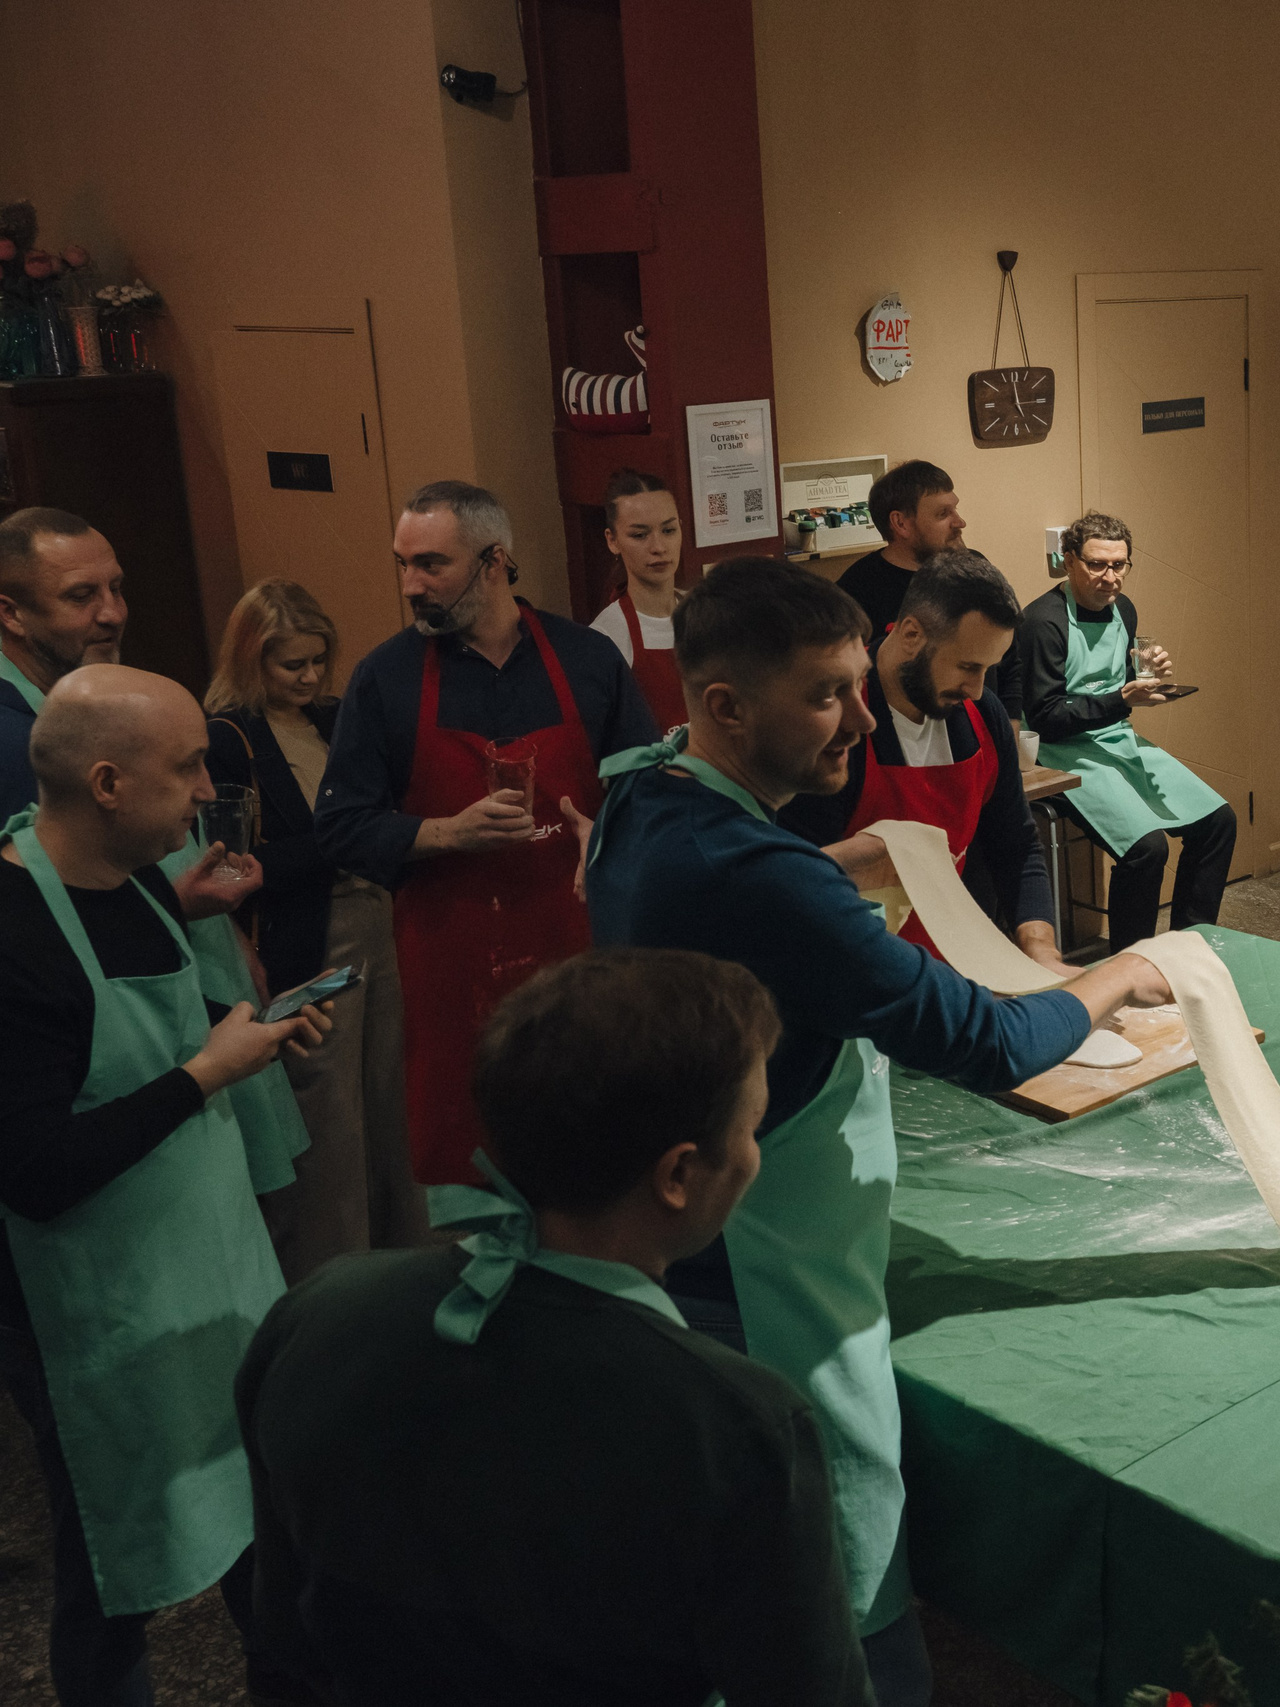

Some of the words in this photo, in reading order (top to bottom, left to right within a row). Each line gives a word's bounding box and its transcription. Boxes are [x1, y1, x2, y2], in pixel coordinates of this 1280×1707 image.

[872, 318, 910, 343] ФАРТ
[710, 432, 749, 443] Оставьте
[717, 442, 744, 451] отзыв
[809, 486, 834, 497] AHMAD
[834, 485, 847, 494] TEA
